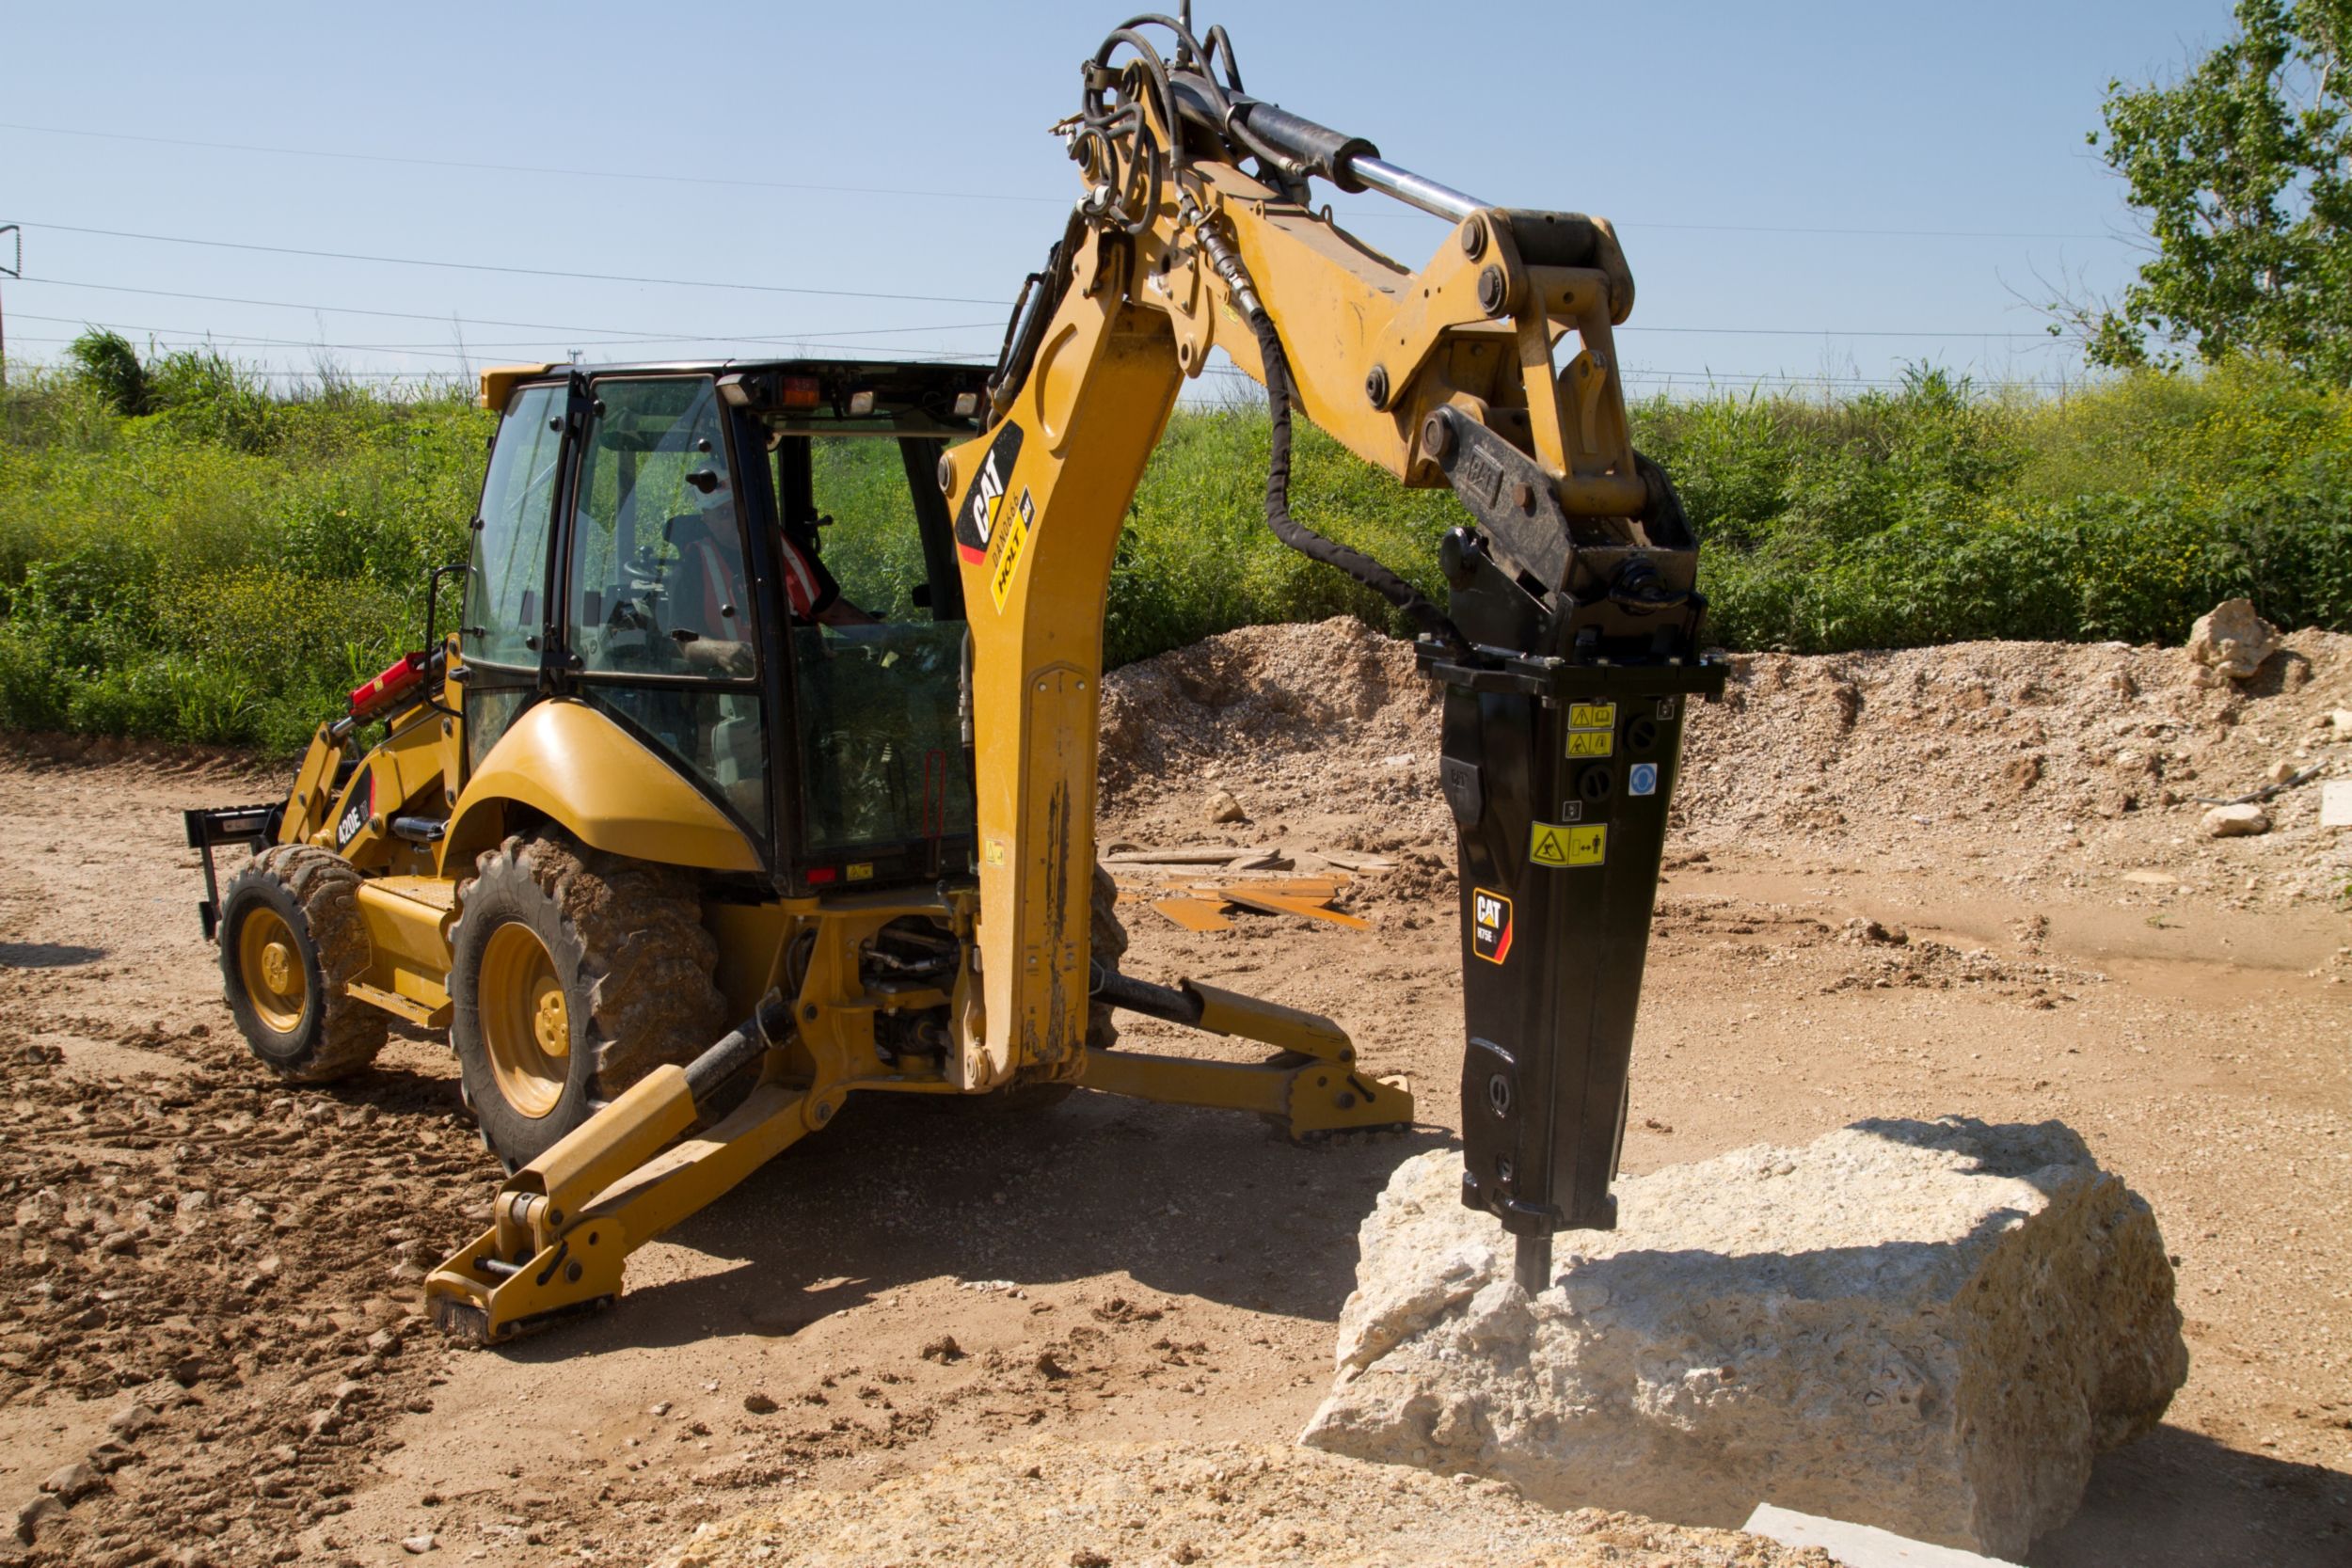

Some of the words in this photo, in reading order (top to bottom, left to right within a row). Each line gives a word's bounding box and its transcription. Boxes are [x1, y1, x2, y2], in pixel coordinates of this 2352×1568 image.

[973, 447, 1004, 544] CAT
[998, 527, 1020, 594] HOLT
[1022, 495, 1031, 524] CAT
[339, 806, 361, 844] 420E
[1477, 895, 1501, 929] CAT
